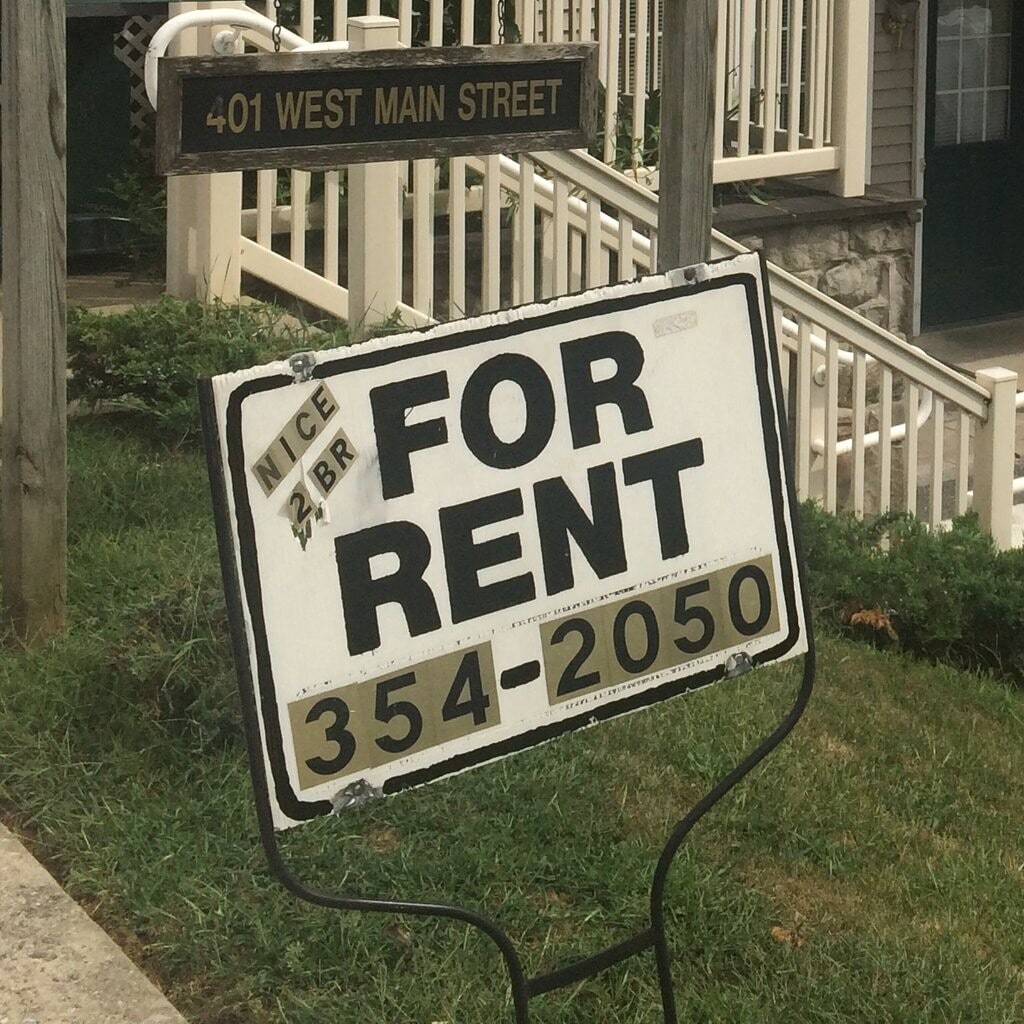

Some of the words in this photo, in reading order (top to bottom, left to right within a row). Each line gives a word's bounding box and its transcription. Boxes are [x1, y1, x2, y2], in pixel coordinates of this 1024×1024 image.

[206, 92, 262, 134] 401
[276, 88, 363, 130] WEST
[375, 84, 445, 125] MAIN
[458, 79, 563, 121] STREET
[256, 385, 336, 491] NICE
[289, 492, 313, 524] 2
[312, 438, 355, 493] BR
[369, 330, 654, 501] FOR
[334, 437, 705, 657] RENT
[304, 564, 772, 776] 354-2050
